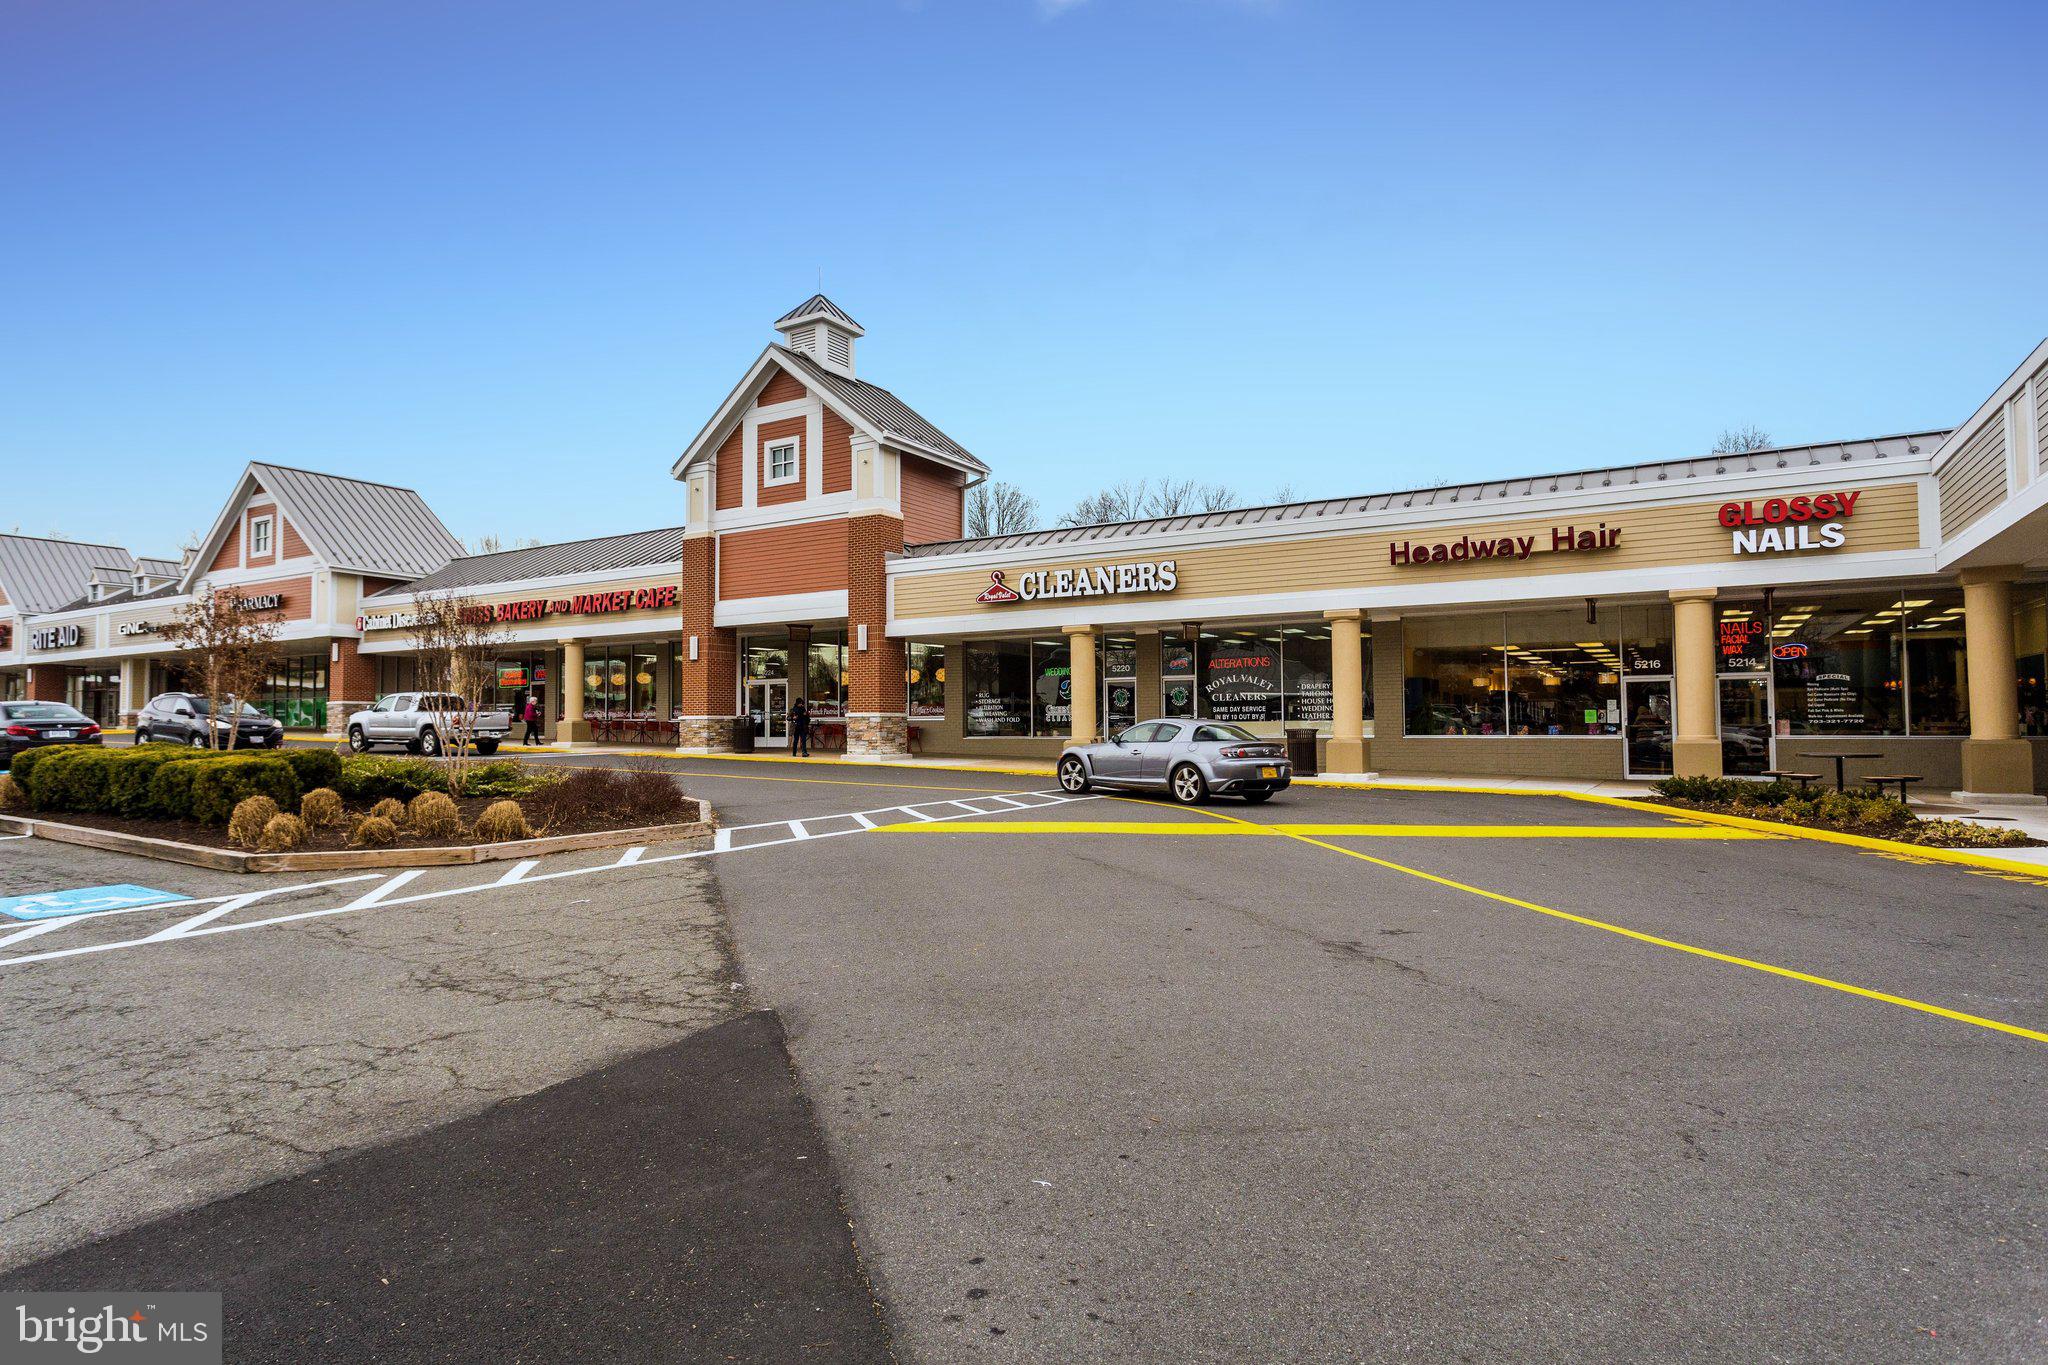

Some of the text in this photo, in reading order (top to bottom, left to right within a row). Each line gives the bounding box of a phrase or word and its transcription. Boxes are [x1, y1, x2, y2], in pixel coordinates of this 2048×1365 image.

[1718, 491, 1861, 527] GLOSSY
[1390, 523, 1621, 565] Headway Hair
[1732, 522, 1846, 554] NAILS
[1019, 561, 1178, 600] CLEANERS
[496, 600, 545, 622] BAKERY
[549, 600, 569, 614] AND
[570, 590, 633, 614] MARKET
[635, 586, 677, 609] CAFE
[118, 621, 146, 635] GNC
[1720, 621, 1762, 635] NAILS
[32, 627, 56, 650] RITE
[57, 624, 80, 647] AID
[1721, 634, 1750, 644] FACIAL
[1722, 645, 1743, 655] WAX
[1773, 646, 1808, 657] OPEN
[1111, 665, 1131, 673] 5220
[1208, 656, 1271, 669] ALTERATIONS
[1634, 659, 1661, 670] 5216
[1728, 658, 1756, 667] 5214
[1205, 674, 1274, 693] ROYAL VALET
[1212, 692, 1267, 702] CLEANERS
